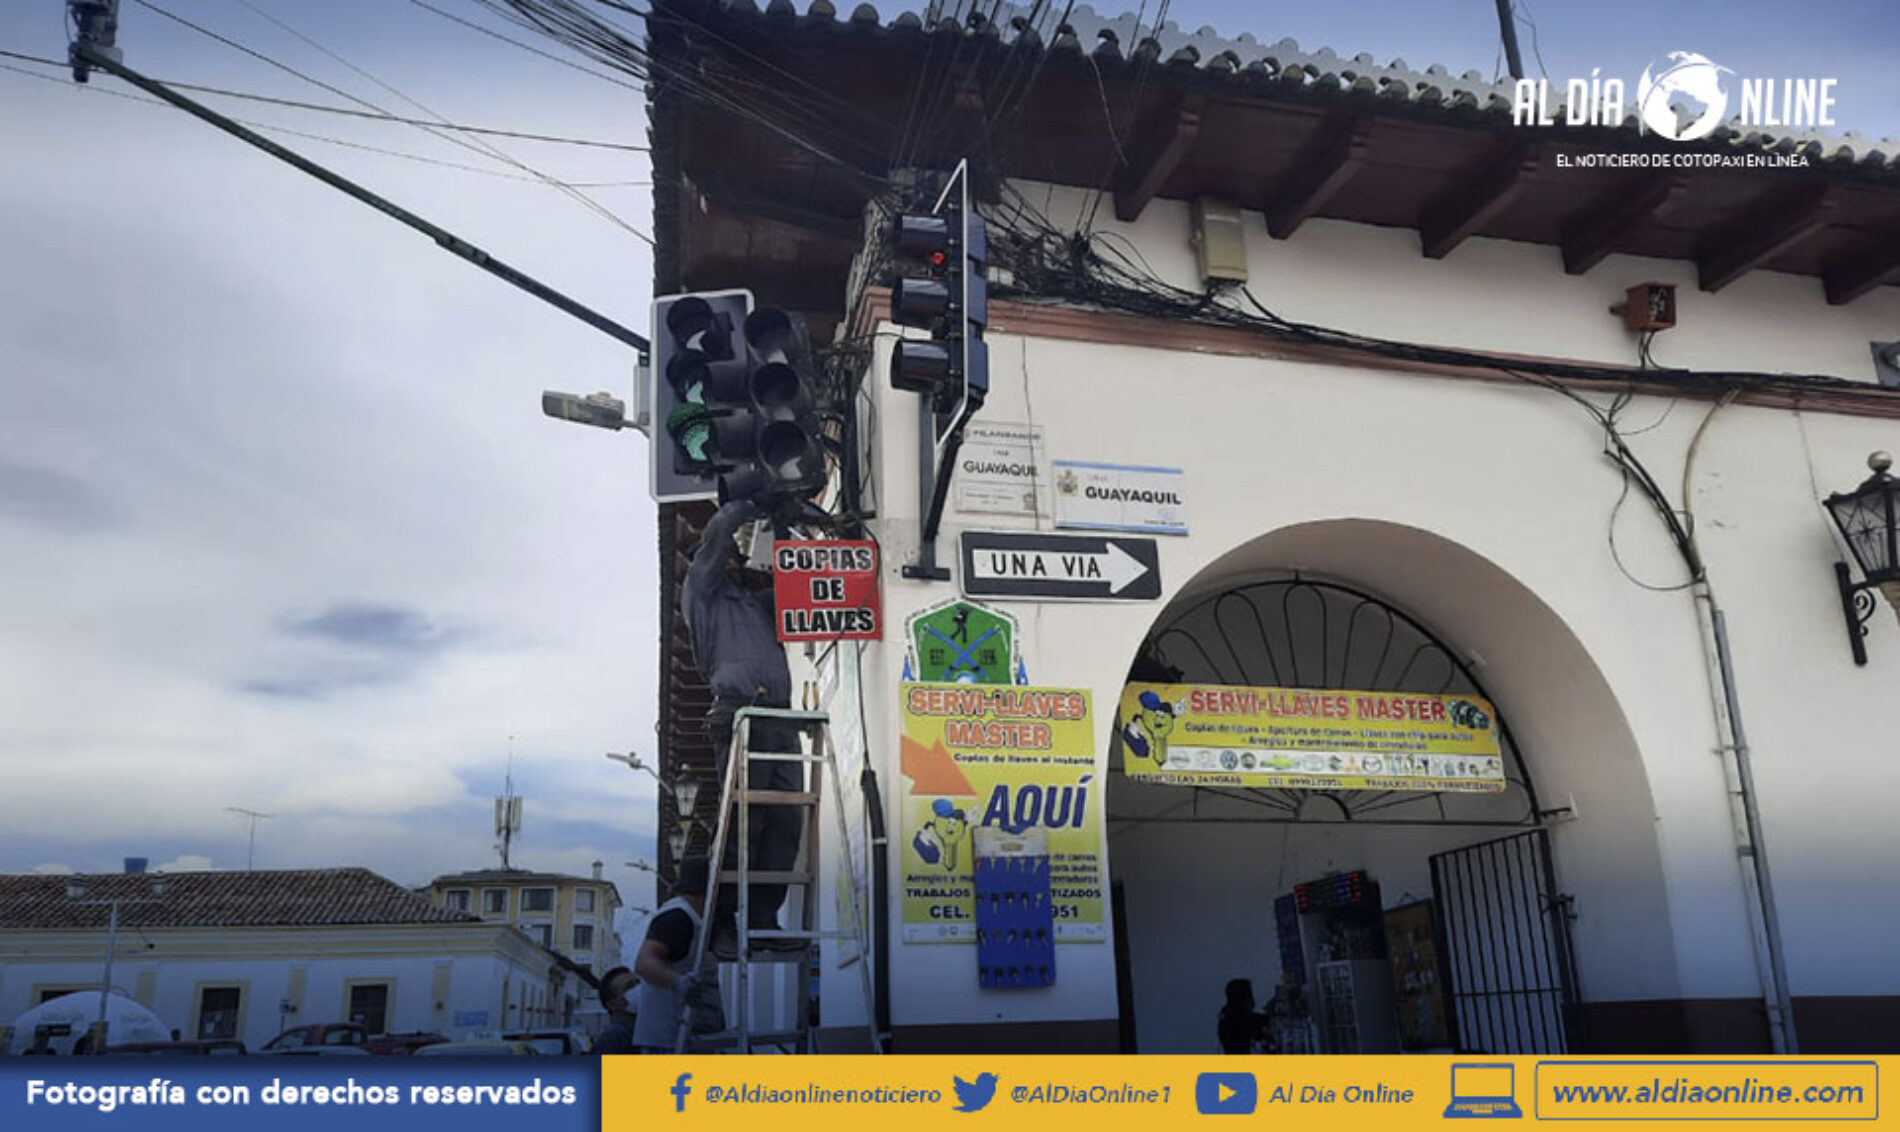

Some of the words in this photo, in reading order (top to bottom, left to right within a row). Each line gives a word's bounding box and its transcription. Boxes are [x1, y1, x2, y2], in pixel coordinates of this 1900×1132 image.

[1085, 485, 1182, 505] GUAYAQUIL
[776, 546, 874, 571] COPIAS
[991, 552, 1047, 576] UNA
[1062, 555, 1102, 578] VIA
[810, 577, 846, 602] DE
[783, 607, 876, 635] LLAVES
[908, 687, 1087, 721] SERVI-LLAVES
[1190, 689, 1350, 718] SERVI-LLAVES
[1356, 696, 1448, 722] MASTER
[946, 720, 1053, 749] MASTER
[953, 753, 990, 764] Copias
[993, 754, 1005, 763] de
[1008, 755, 1038, 764] llaves
[1041, 755, 1051, 764] al
[1053, 756, 1095, 766] instante
[981, 774, 1094, 836] AQUÍ
[906, 888, 971, 898] TRABAJOS
[1051, 888, 1102, 898] TIZADOS
[929, 905, 971, 918] CEL.
